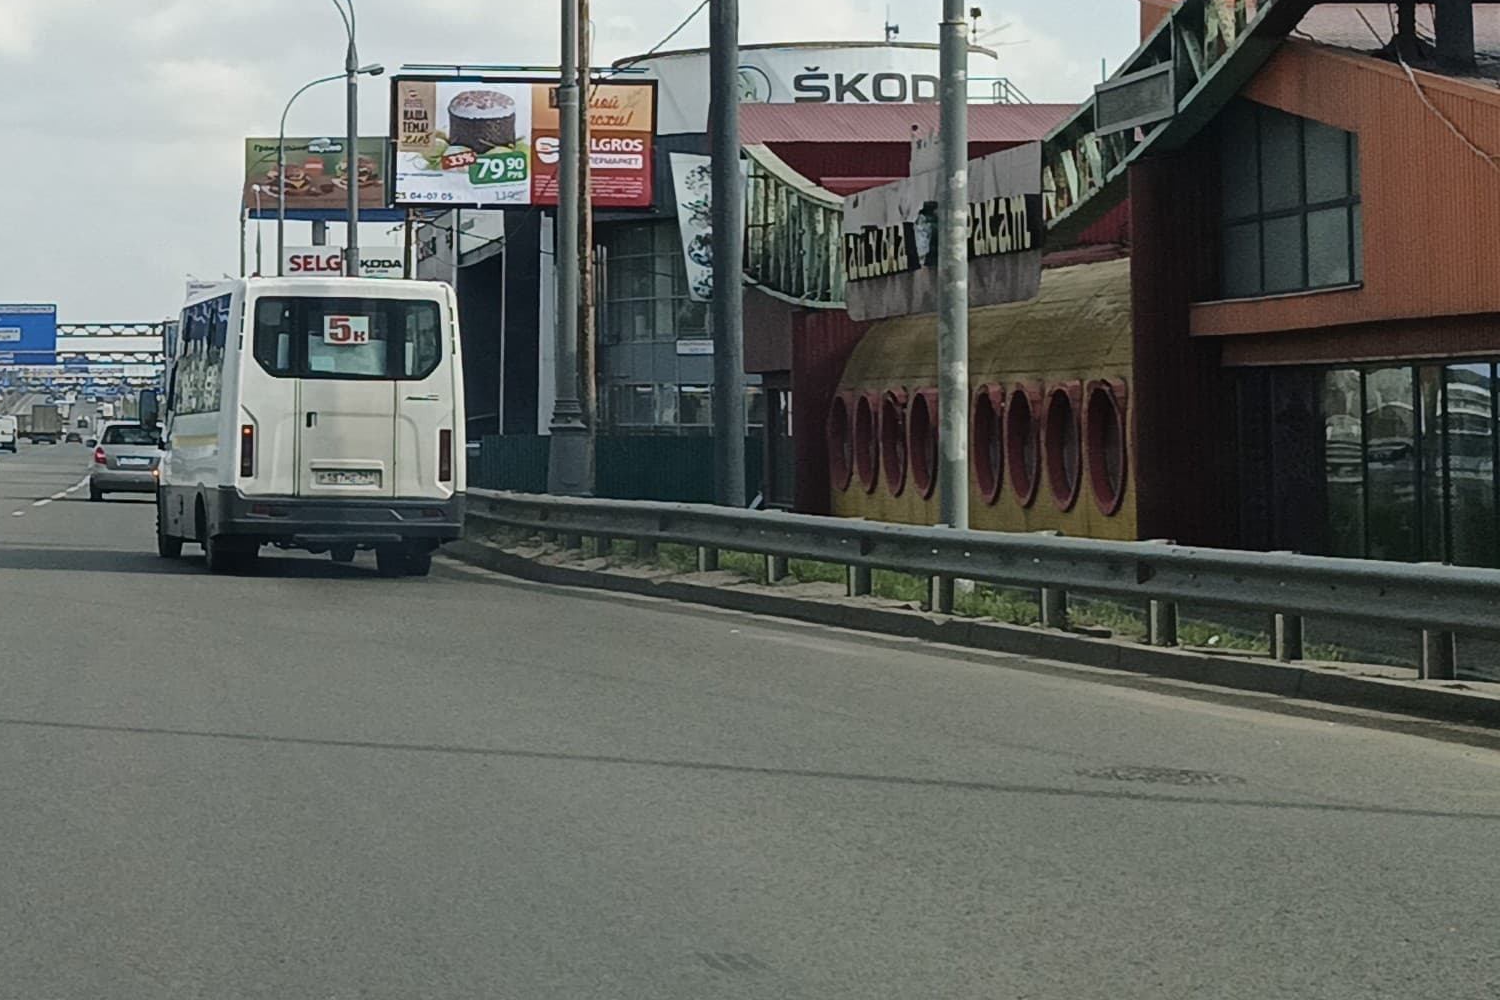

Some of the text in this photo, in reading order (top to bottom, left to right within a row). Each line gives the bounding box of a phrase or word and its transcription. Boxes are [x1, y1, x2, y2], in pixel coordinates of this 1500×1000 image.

[793, 65, 940, 103] ŠKOD
[476, 157, 524, 180] 79 90
